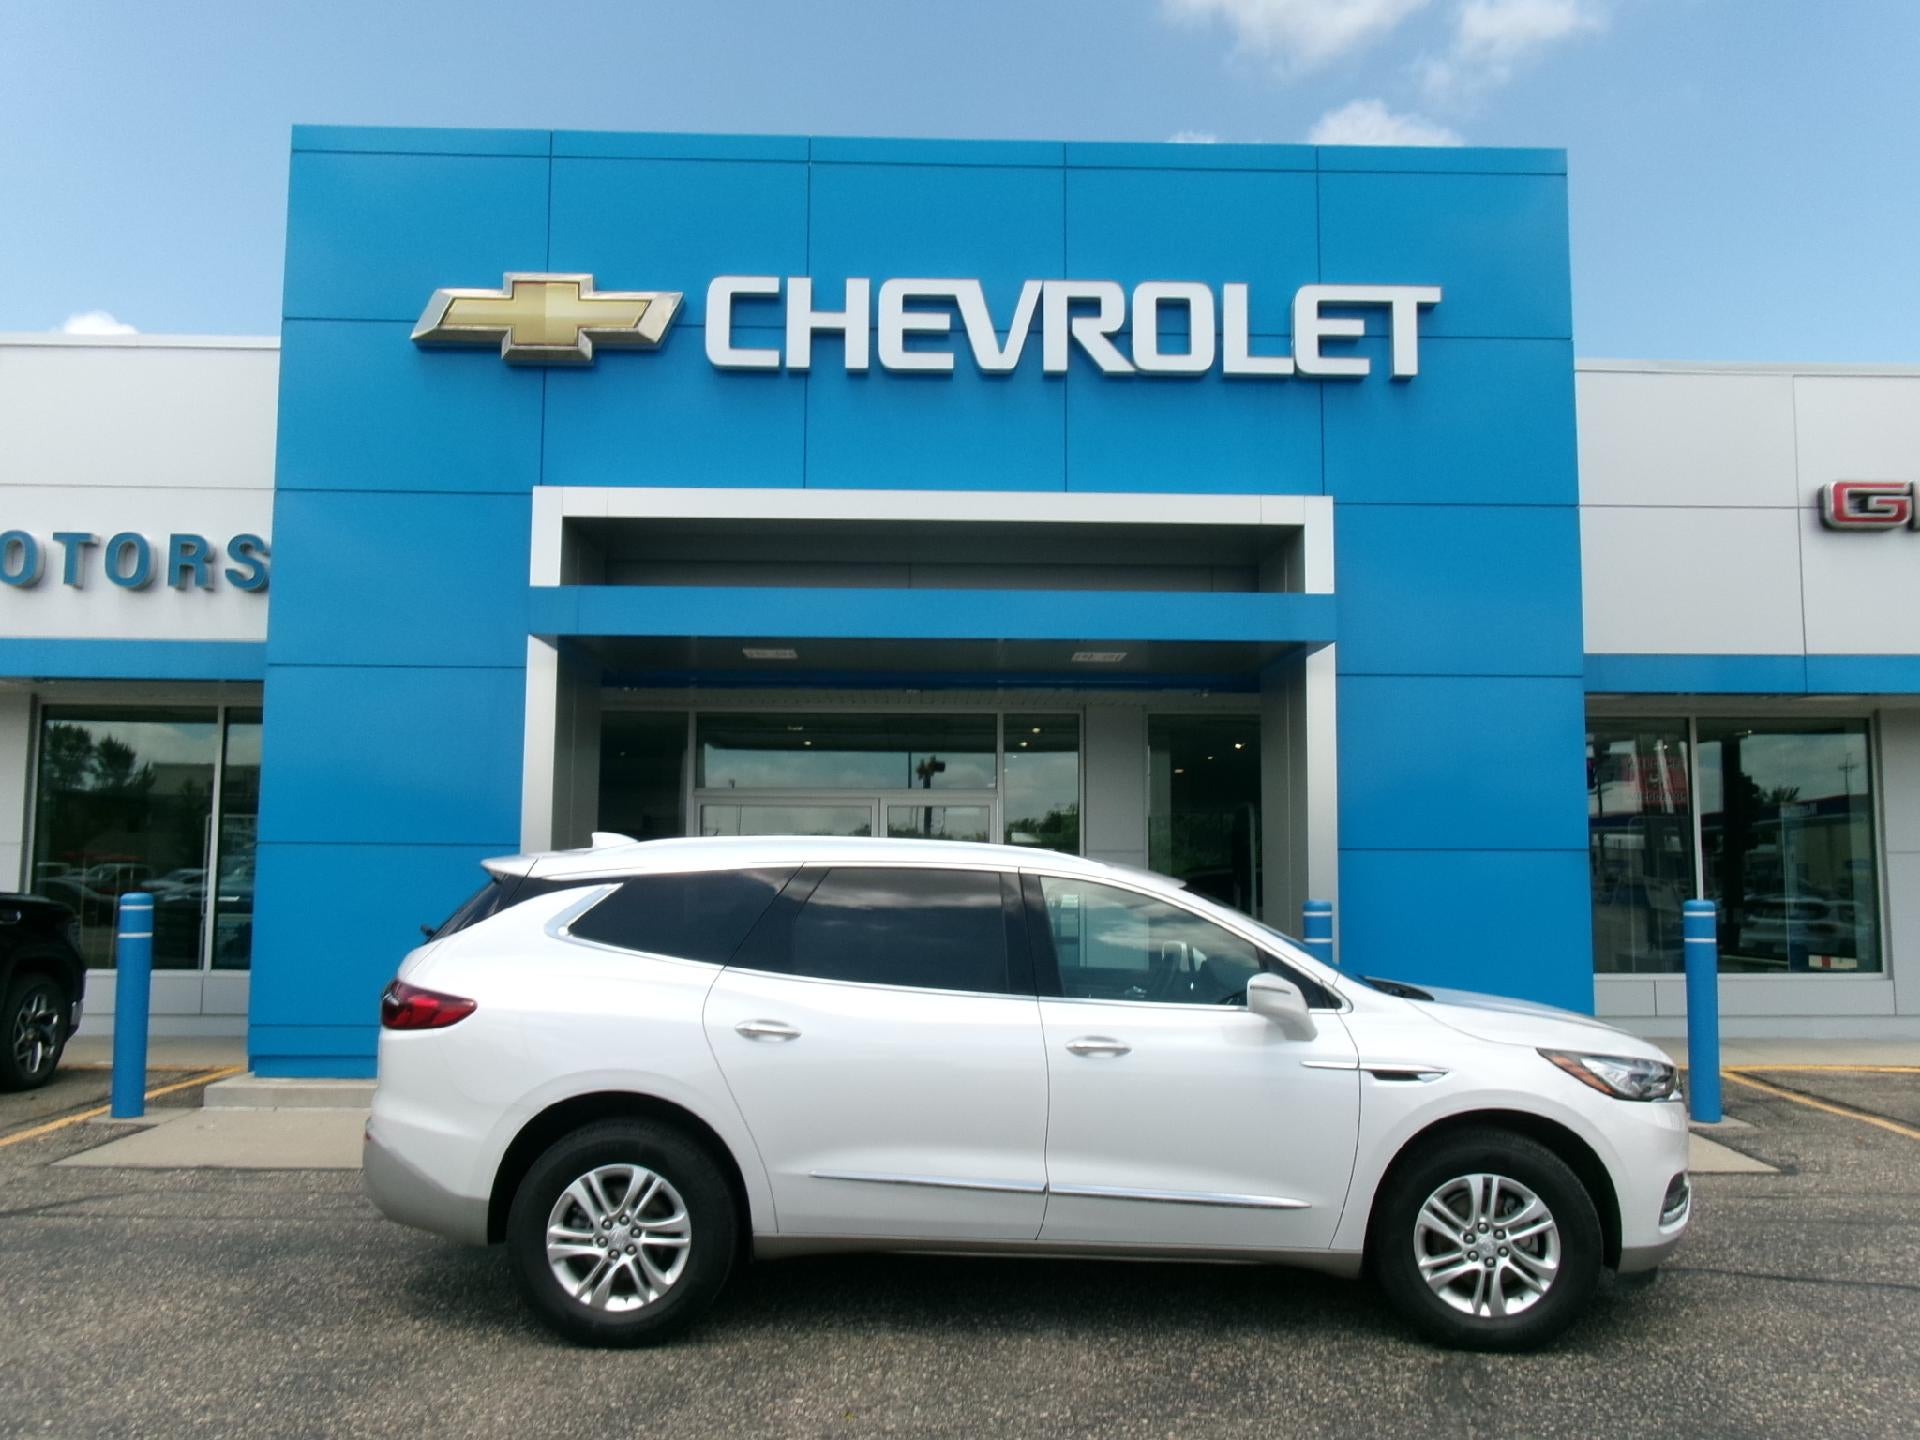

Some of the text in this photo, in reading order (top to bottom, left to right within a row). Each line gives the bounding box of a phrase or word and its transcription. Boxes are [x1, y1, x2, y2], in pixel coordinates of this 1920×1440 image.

[705, 275, 1442, 377] CHEVROLET
[1821, 480, 1920, 531] G
[0, 530, 270, 591] OTORS
